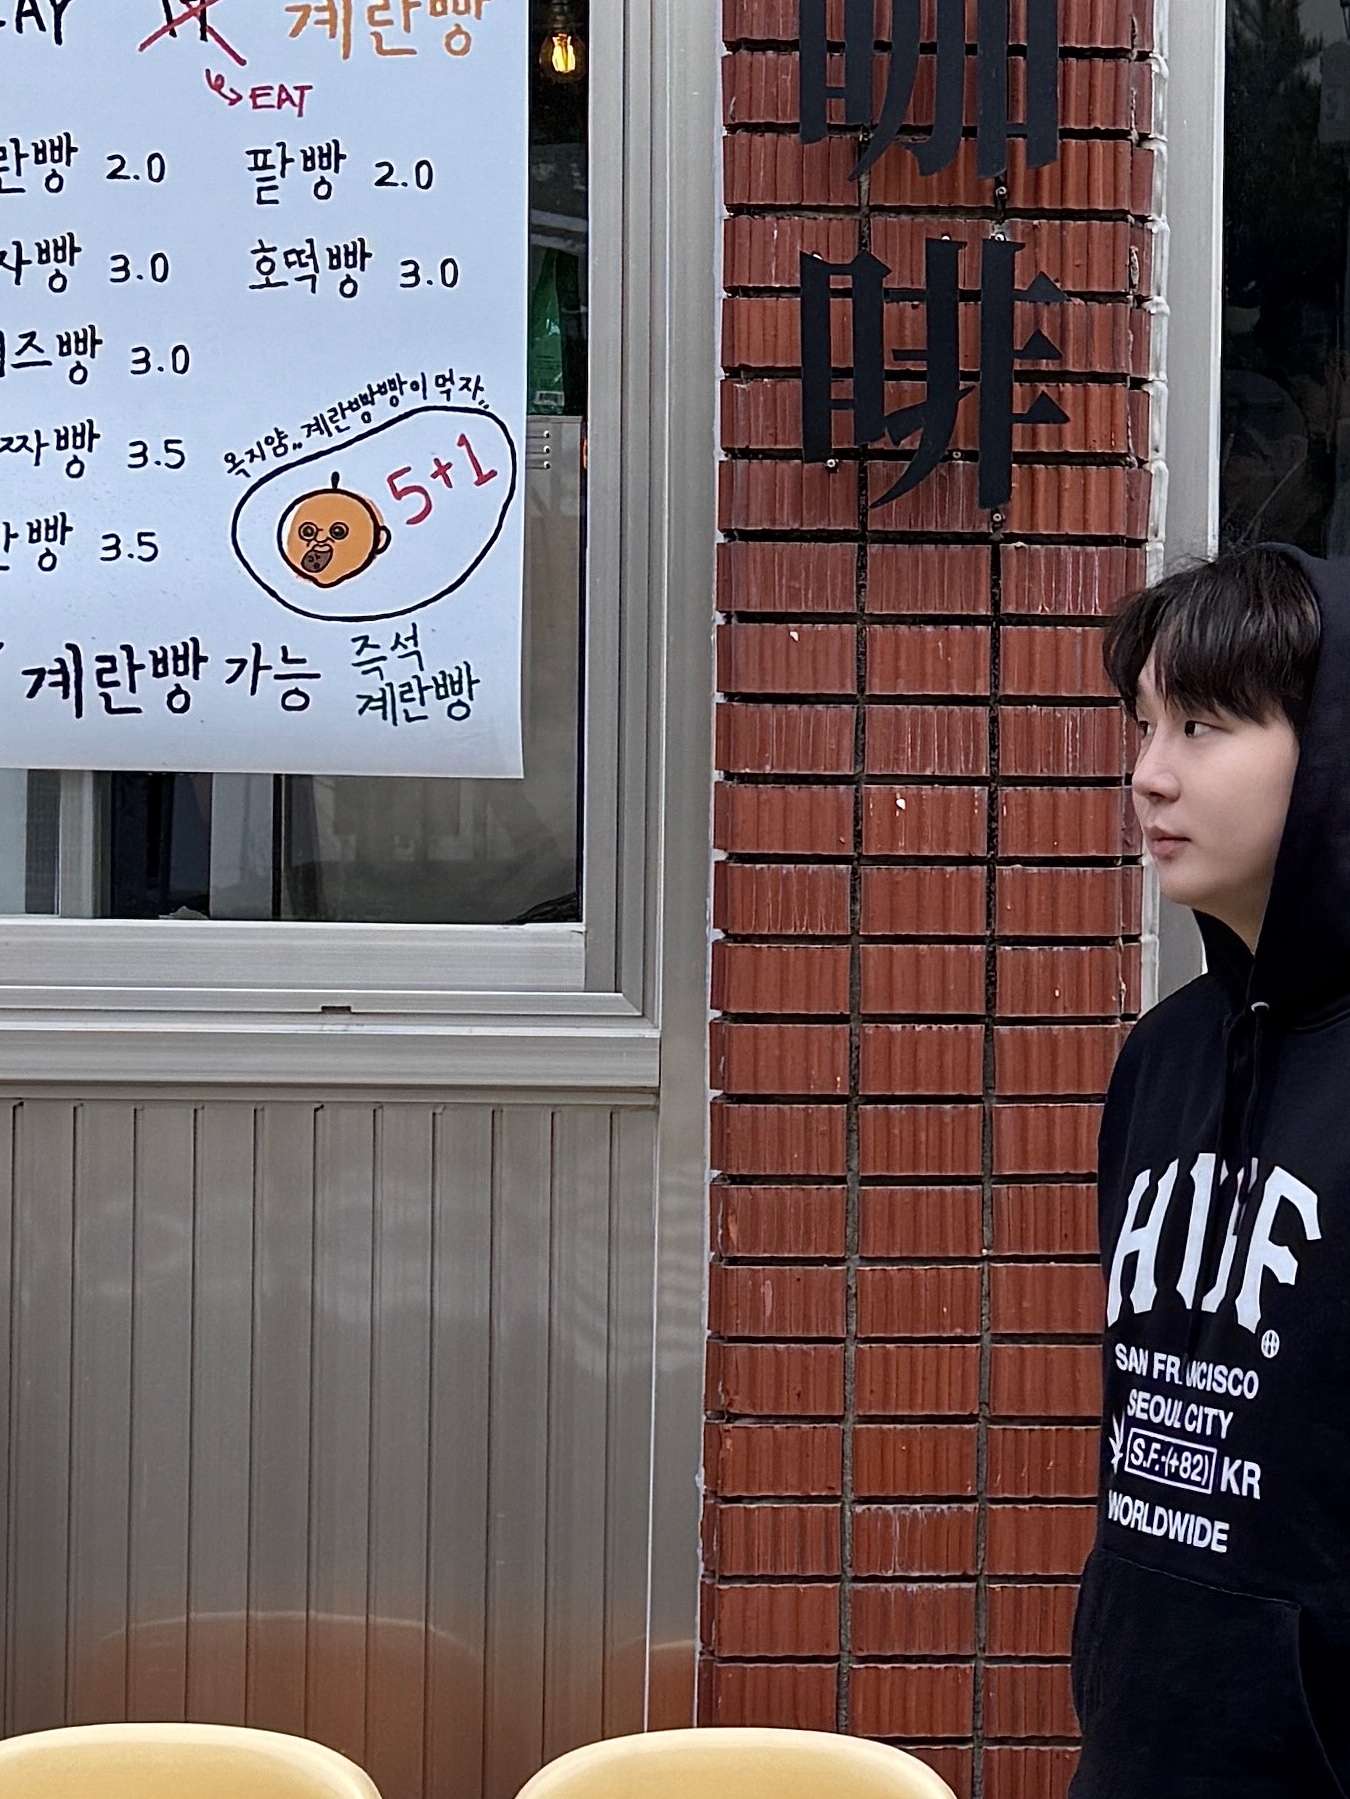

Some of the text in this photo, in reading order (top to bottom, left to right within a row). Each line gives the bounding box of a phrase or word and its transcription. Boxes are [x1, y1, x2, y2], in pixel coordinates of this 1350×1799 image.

[285, 0, 491, 60] 계란빵
[249, 84, 313, 118] EAT
[106, 153, 166, 183] 2.0
[245, 139, 434, 205] 팥빵 2.0
[109, 253, 169, 283] 3.0
[249, 237, 459, 299] 호떡빵 3.0
[130, 345, 190, 375] 3.0
[300, 371, 428, 438] 계란빵빵이
[128, 439, 186, 469] 3.5
[386, 433, 499, 526] 5+1
[99, 532, 159, 562] 3.5
[21, 636, 322, 719] 계란빵 가능
[351, 623, 425, 680] 즉석
[356, 661, 481, 727] 계란빵
[1106, 1152, 1322, 1334] HUF
[1115, 1343, 1259, 1400] SAN FRNCISCO
[1127, 1388, 1234, 1440] SEOUL CITY
[1220, 1456, 1262, 1500] KR
[1107, 1488, 1230, 1553] WORLDWIDE
